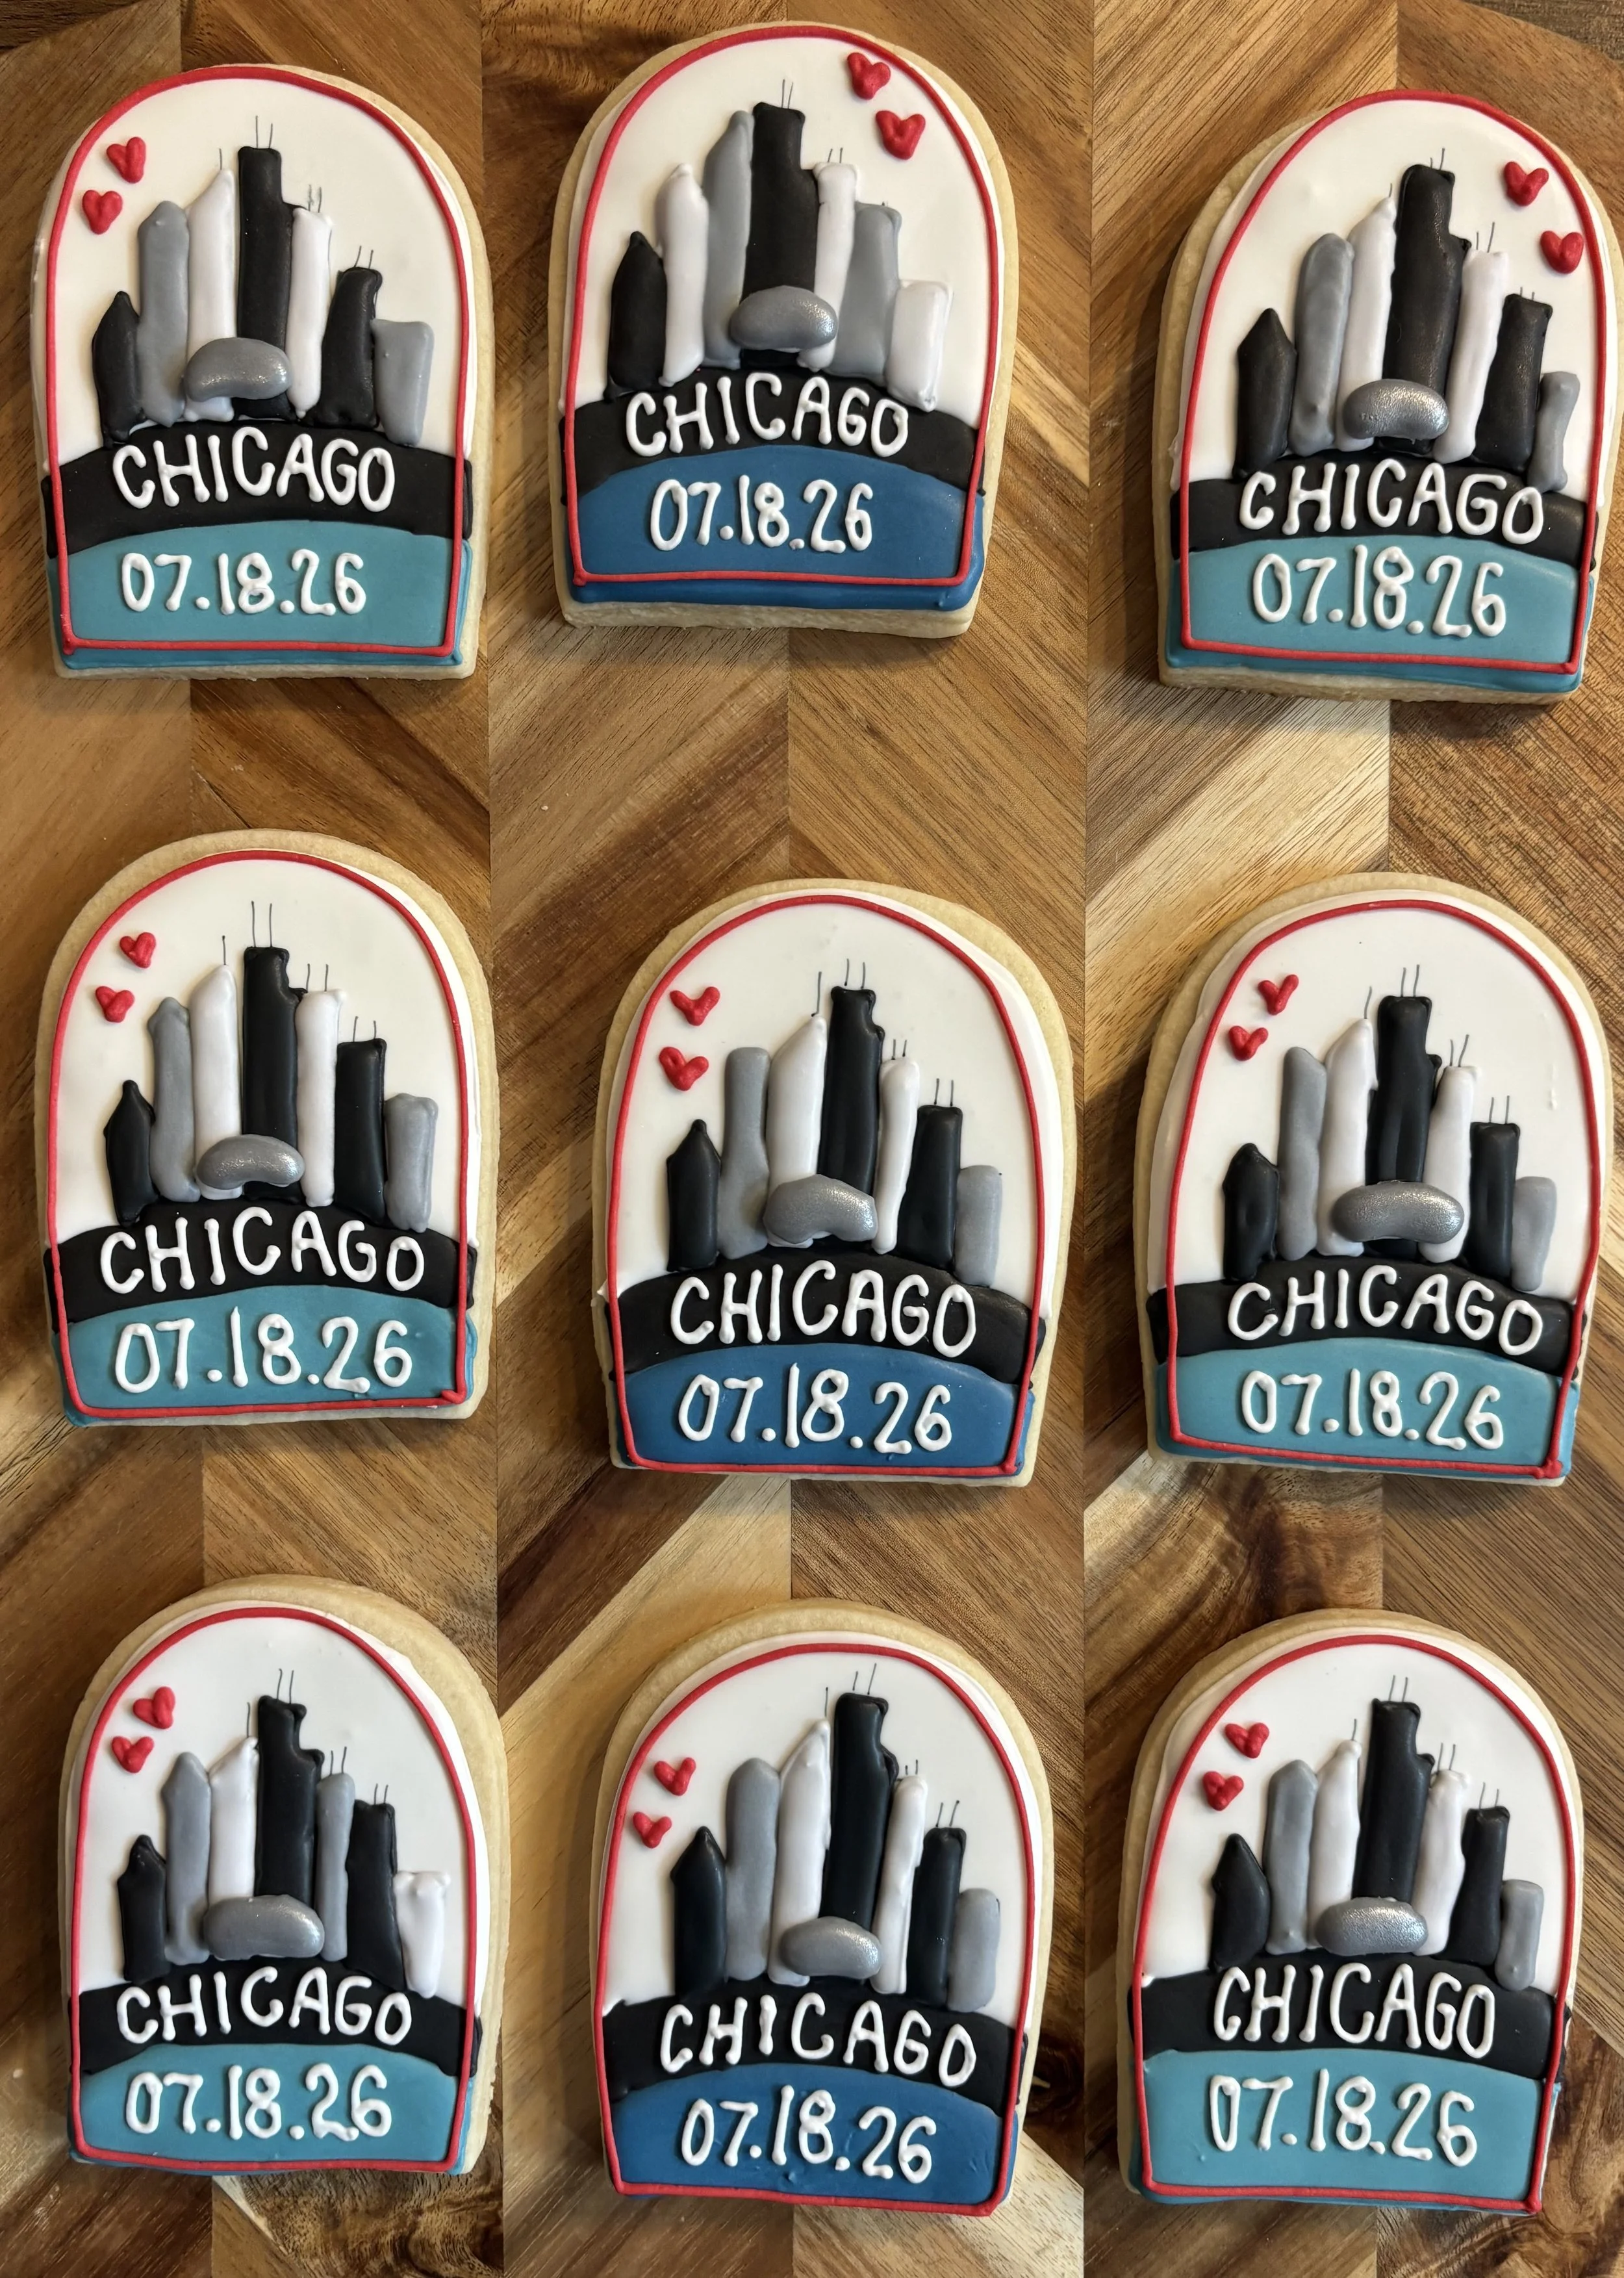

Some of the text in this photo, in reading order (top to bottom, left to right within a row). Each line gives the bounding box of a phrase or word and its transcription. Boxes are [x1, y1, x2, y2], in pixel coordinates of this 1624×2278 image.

[625, 371, 910, 458] CHICAGO
[112, 425, 396, 513] CHICAGO
[649, 473, 875, 555] 07.18.26
[1239, 457, 1545, 545] CHICAGO
[120, 546, 369, 618] 07.18.26
[1252, 541, 1509, 639] 07.18.26
[99, 1205, 426, 1295] CHICAGO
[114, 1305, 414, 1395] 07.18.26
[670, 1259, 978, 1359] CHICAGO
[1227, 1264, 1545, 1357] CHICAGO
[678, 1361, 954, 1456] 07.18.26
[1241, 1366, 1506, 1452] 07.18.26
[116, 1965, 413, 2047] CHICAGO
[659, 1991, 978, 2088] CHICAGO
[1213, 1962, 1497, 2060] CHICAGO
[125, 2061, 394, 2143] 07.18.26
[680, 2083, 938, 2185] 07.18.26
[1209, 2067, 1479, 2169] 07.18.26
